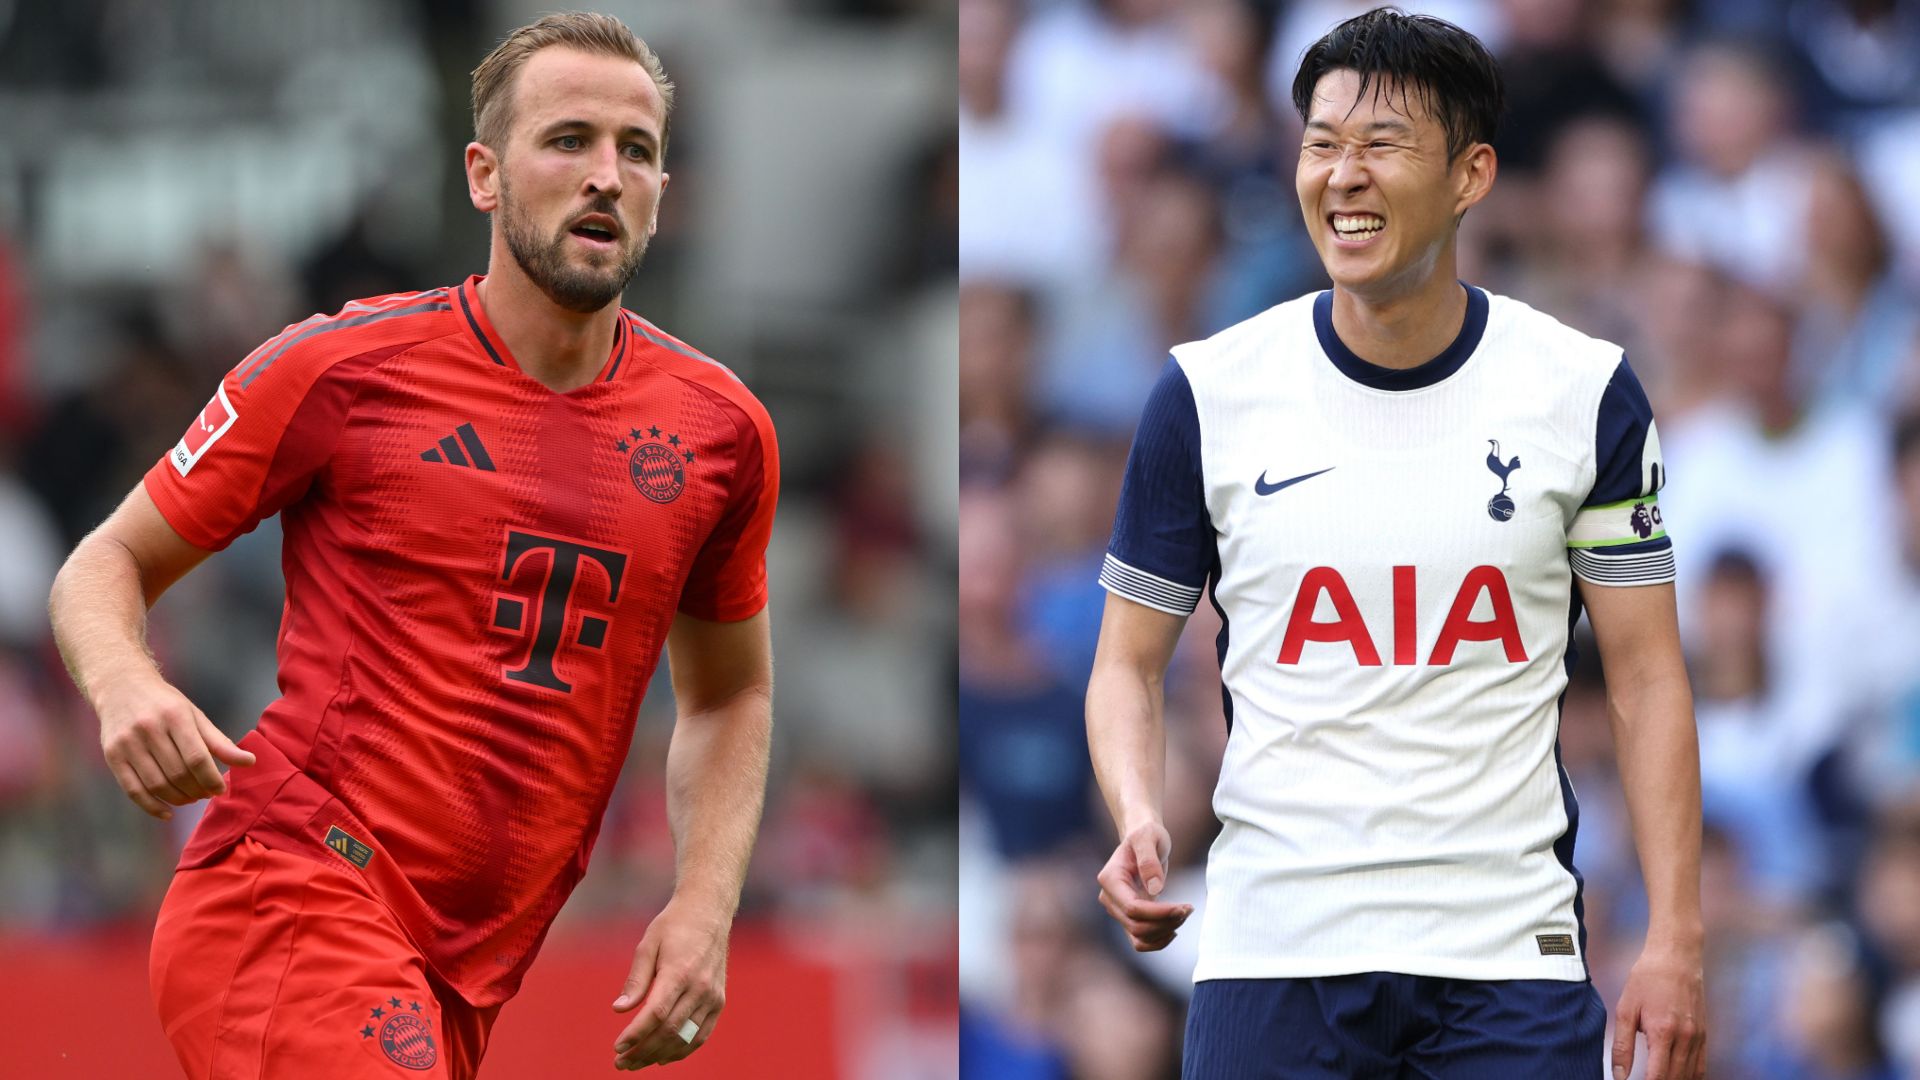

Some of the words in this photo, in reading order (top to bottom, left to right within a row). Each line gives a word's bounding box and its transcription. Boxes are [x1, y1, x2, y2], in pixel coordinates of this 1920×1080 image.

[634, 452, 646, 466] FC
[644, 447, 681, 471] BAYERN
[1276, 565, 1530, 667] AIA
[384, 1027, 394, 1041] FC
[390, 1016, 429, 1037] BAYERN
